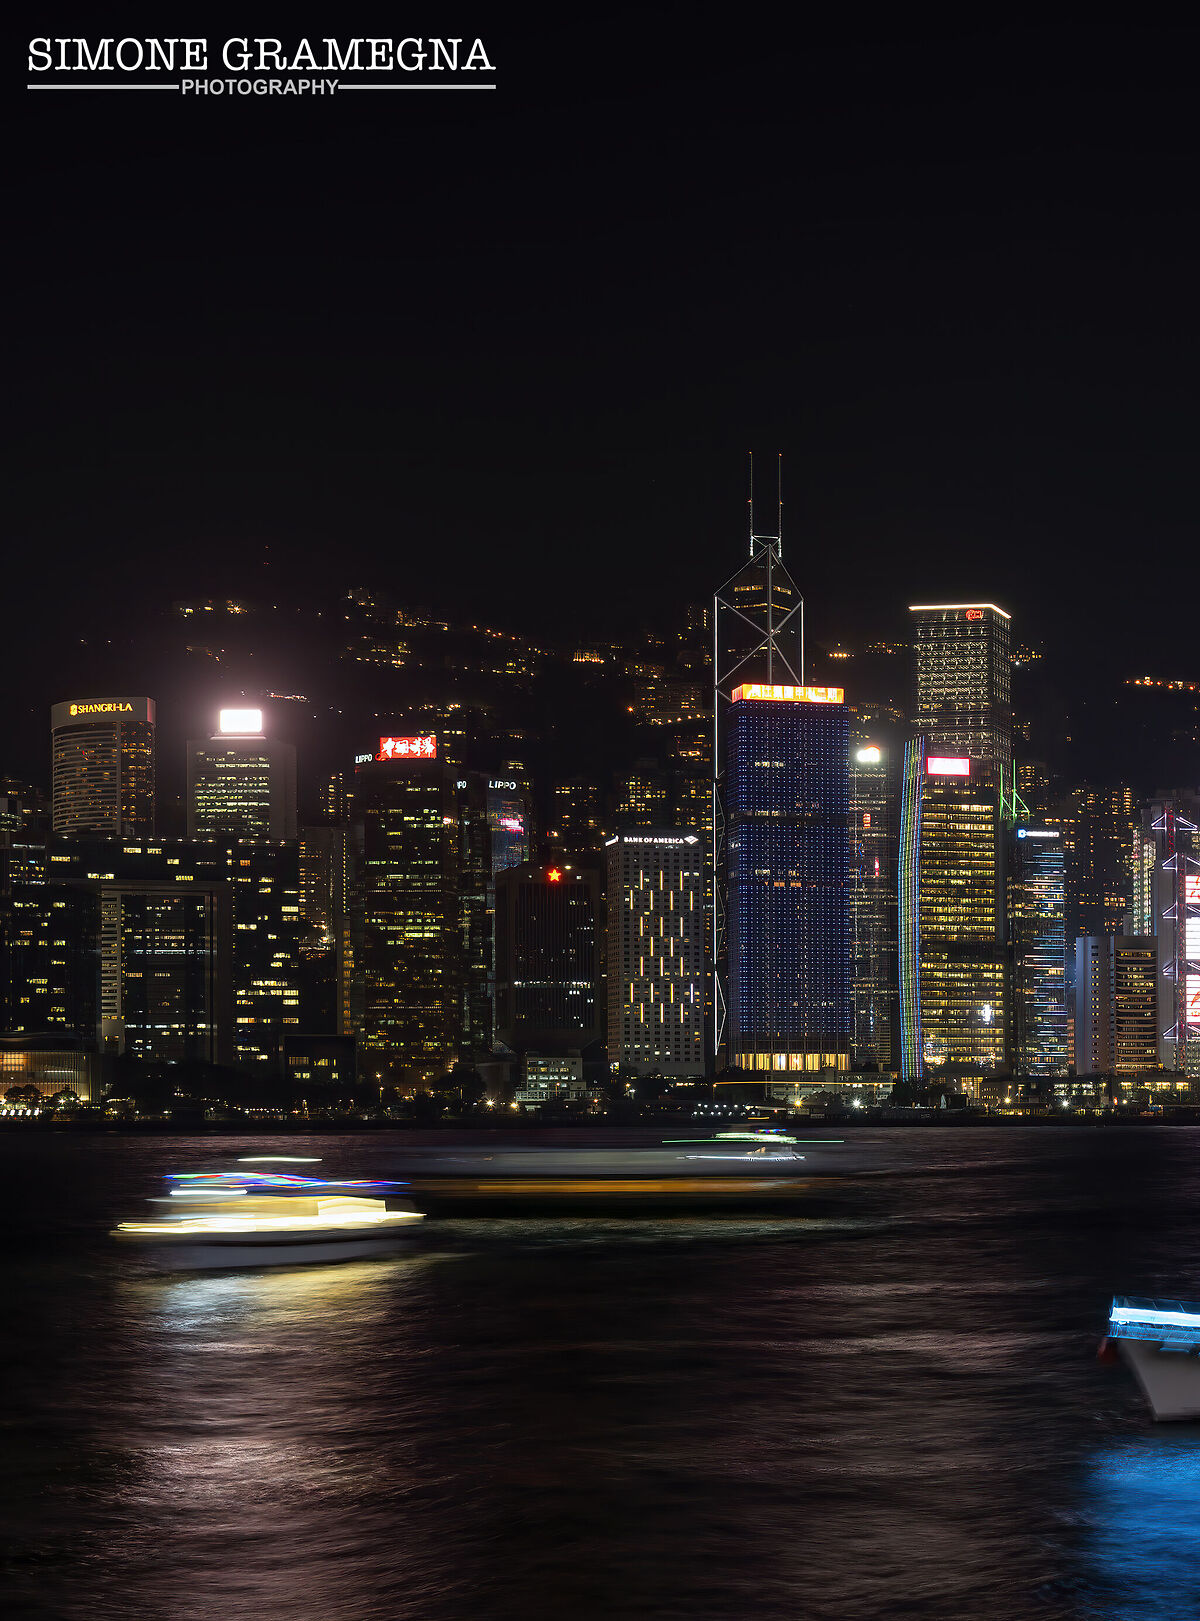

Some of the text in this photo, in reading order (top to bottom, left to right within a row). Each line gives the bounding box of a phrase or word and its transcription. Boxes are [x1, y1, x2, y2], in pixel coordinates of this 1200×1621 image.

[77, 702, 134, 714] SHANGRI-LA
[355, 753, 373, 764] LIPPO
[488, 780, 517, 790] LIPPO
